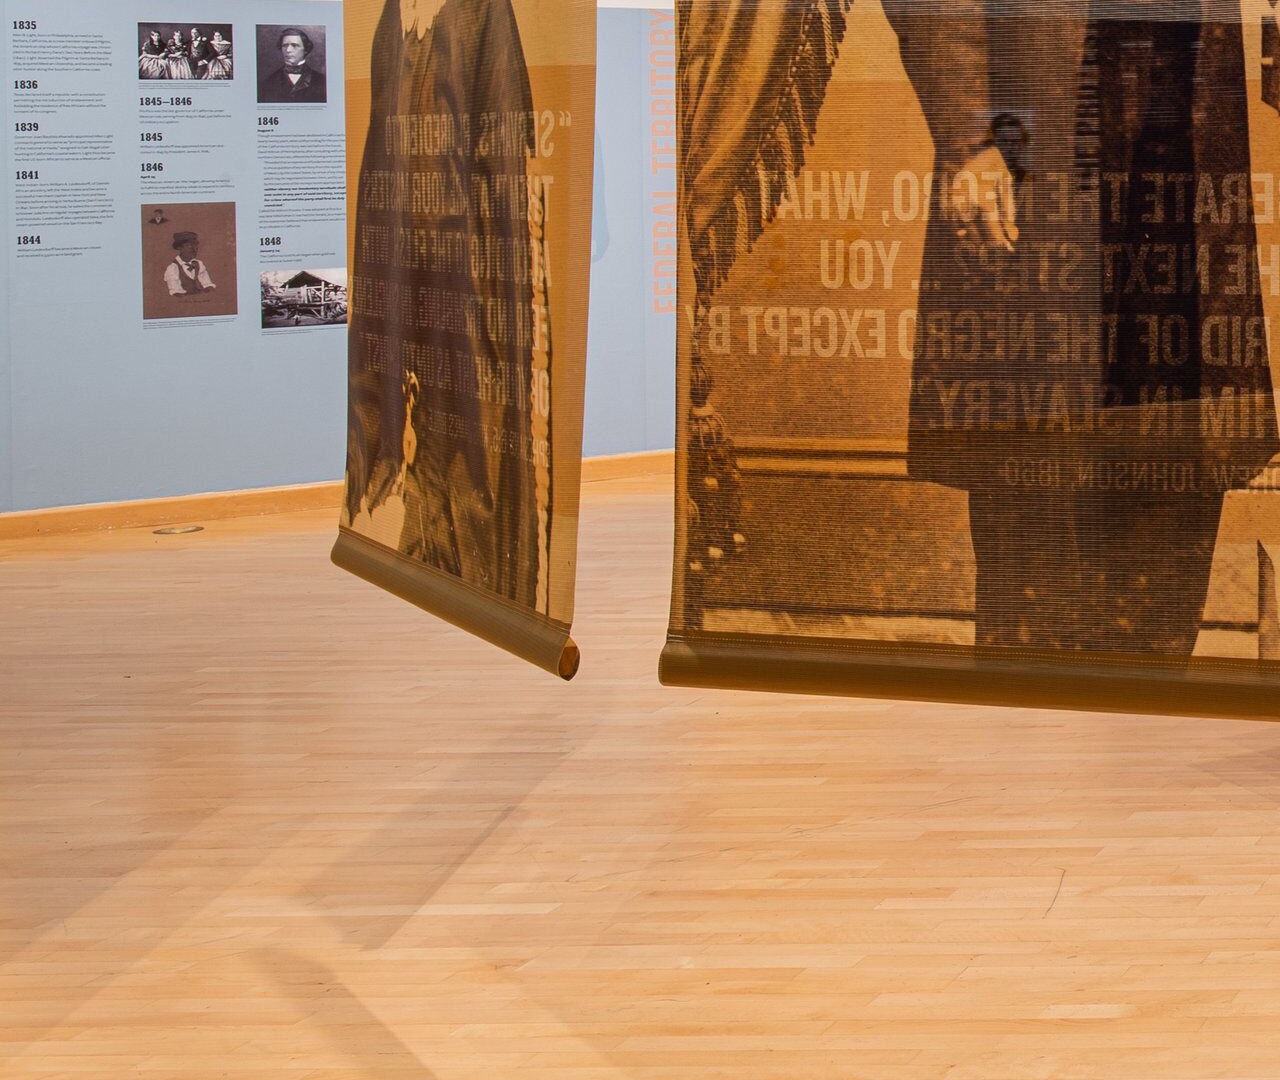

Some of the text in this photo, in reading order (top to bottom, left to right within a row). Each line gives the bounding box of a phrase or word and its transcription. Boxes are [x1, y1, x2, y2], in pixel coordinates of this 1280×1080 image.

[13, 20, 37, 30] 1835
[14, 80, 38, 89] 1836
[257, 117, 279, 126] 1846
[15, 122, 39, 132] 1839
[140, 132, 163, 142] 1845
[141, 163, 164, 172] 1846
[16, 170, 39, 180] 1841
[17, 235, 41, 245] 1844
[260, 237, 281, 246] 1848
